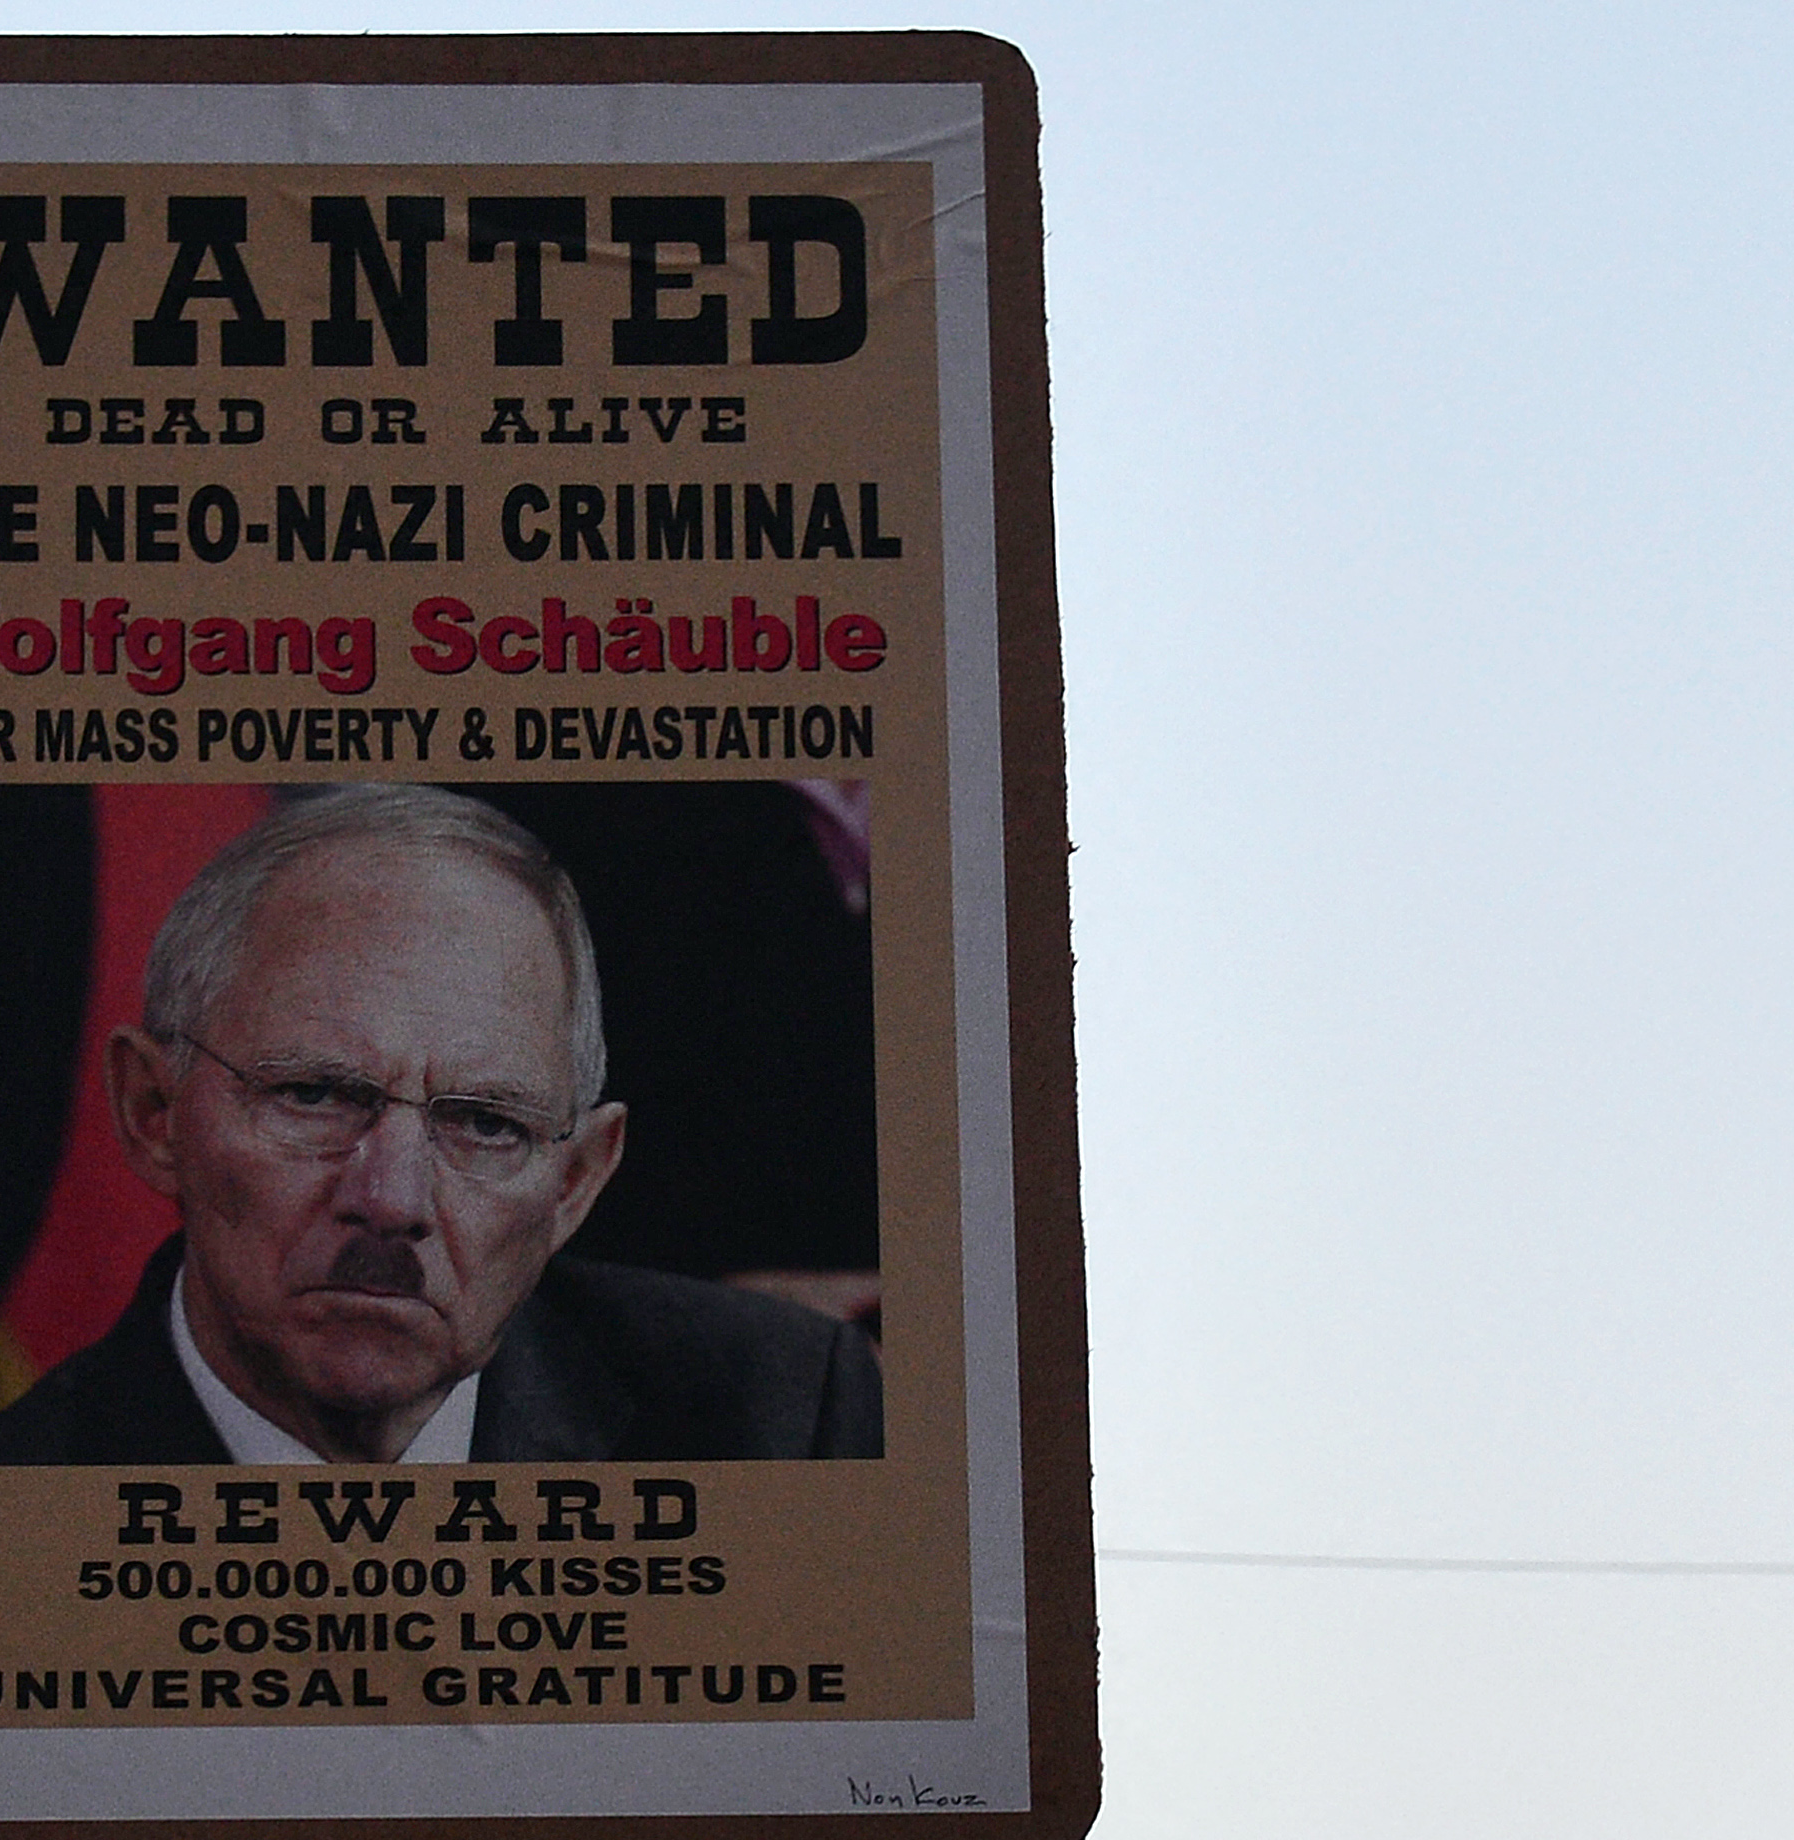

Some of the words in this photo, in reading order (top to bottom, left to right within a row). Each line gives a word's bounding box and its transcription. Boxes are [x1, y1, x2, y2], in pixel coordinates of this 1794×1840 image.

[46, 398, 264, 444] DEAD
[321, 398, 426, 444] OR
[481, 397, 746, 444] ALIVE
[75, 484, 464, 563] NEO-NAZI
[502, 483, 902, 562] CRIMINAL
[410, 595, 887, 675] Schäuble
[35, 708, 179, 762] MASS
[198, 708, 439, 762] POVERTY
[459, 707, 495, 761] &
[515, 705, 873, 760] DEVASTATION
[118, 1479, 697, 1544] REWARD
[79, 1558, 466, 1600] 500.000.000
[491, 1556, 726, 1596] KISSES
[179, 1613, 435, 1654] COSMIC
[461, 1612, 627, 1651] LOVE
[422, 1664, 846, 1706] GRATITUDE
